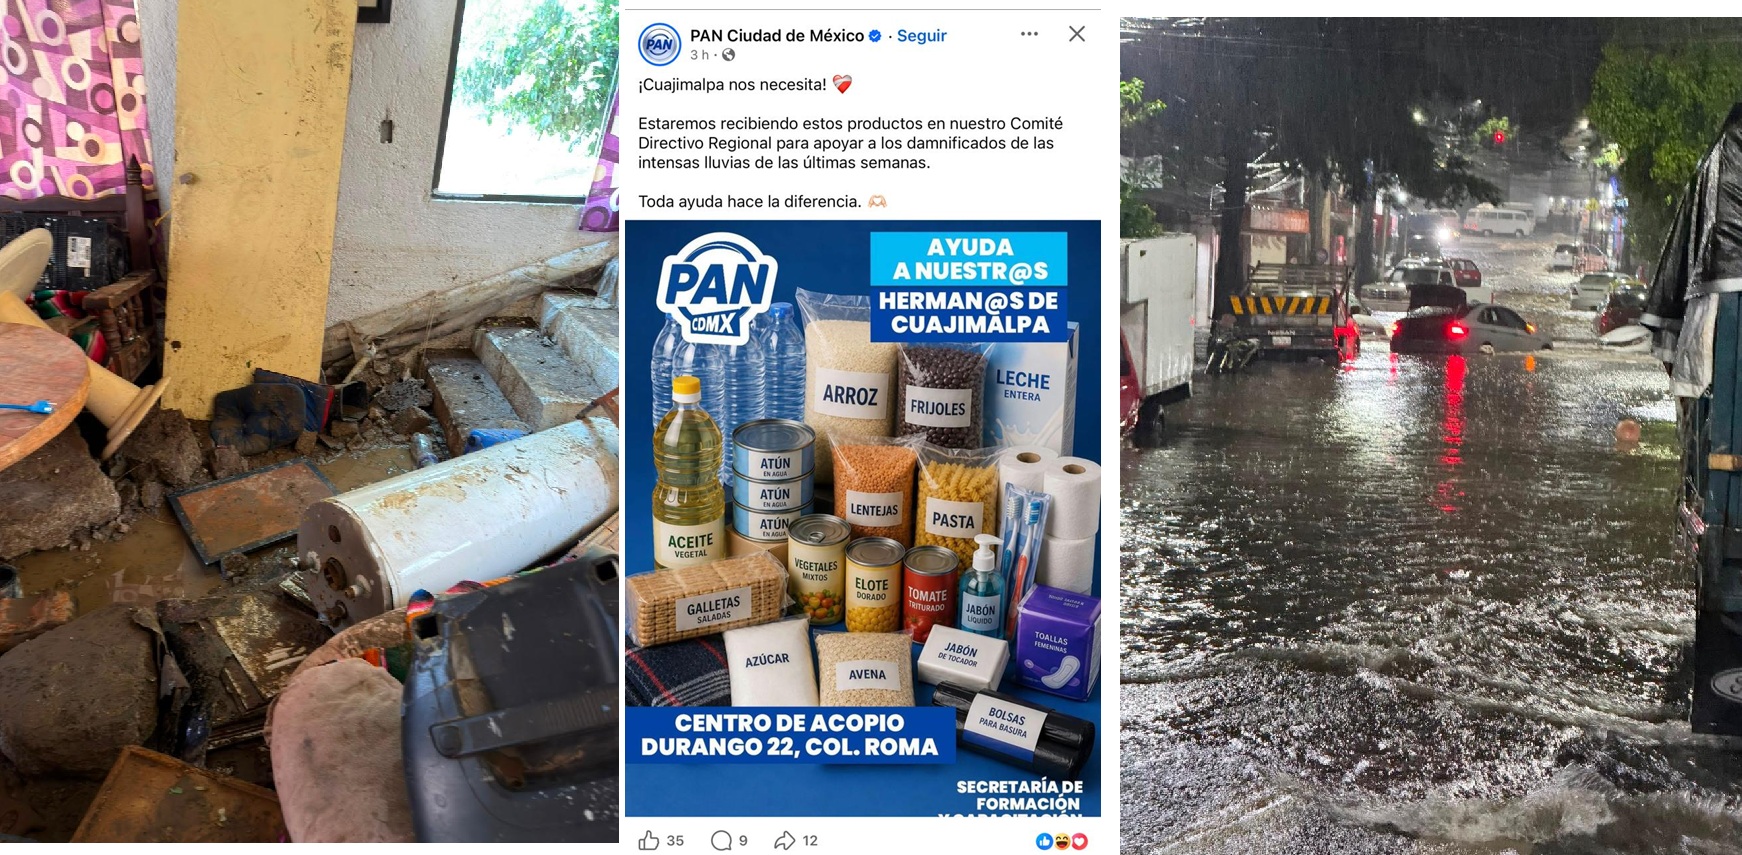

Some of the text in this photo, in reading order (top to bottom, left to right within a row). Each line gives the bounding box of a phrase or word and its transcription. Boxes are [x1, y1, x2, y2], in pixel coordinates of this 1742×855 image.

[646, 38, 673, 50] PAN
[691, 28, 947, 45] PAN Ciudad de México Seguir
[691, 49, 709, 60] 3 h
[639, 78, 826, 93] ¡Cuajimalpa nos necesita!
[639, 117, 1063, 132] Estaremos recibiendo estos productos en nuestro Comité
[639, 136, 1054, 152] Directivo Regional para apoyar a los damnificados de las
[639, 155, 930, 169] intensas lluvias de las últimas semanas.
[639, 195, 861, 210] Toda ayuda hace la diferencia.
[927, 238, 1014, 256] AYUDA
[893, 262, 1048, 285] A NUESTR@S
[665, 264, 769, 305] PAN
[879, 292, 1058, 315] HERMAN@S DE
[692, 312, 737, 333] CDMX
[891, 316, 1050, 333] CUAJIMALPA
[996, 369, 1050, 390] LECHE
[822, 384, 878, 406] ARROZ
[1004, 389, 1041, 402] ENTERA
[911, 399, 966, 416] FRIJOLES
[760, 457, 790, 469] ATÚN
[760, 487, 790, 500] ATÚN
[850, 503, 899, 516] LENTEJAS
[760, 517, 789, 530] ATÚN
[932, 512, 975, 529] PASTA
[668, 532, 714, 549] ACEITE
[674, 550, 708, 559] VEGETAL
[794, 557, 838, 572] VEGETALES
[802, 572, 828, 582] MIXTOS
[855, 577, 889, 592] ELOTE
[856, 591, 886, 601] DORADO
[908, 586, 947, 602] TOMATE
[687, 595, 741, 616] GALLETAS
[908, 601, 945, 612] TRITURADO
[966, 603, 995, 616] JABÓN
[697, 611, 731, 624] SALADAS
[1035, 631, 1068, 646] TOALLAS
[944, 642, 978, 658] JABÓN
[1034, 641, 1068, 654] FEMENINAS
[745, 653, 790, 668] AZÚCAR
[938, 652, 978, 668] DE TOCADOR
[849, 669, 886, 680] AVENA
[675, 714, 905, 732] CENTRO DE ACOPIO
[988, 707, 1026, 726] BOLSAS
[979, 717, 1027, 738] PARA BASURA
[641, 737, 939, 758] DURANGO 22, COL. ROMA
[957, 776, 1083, 793] SECRETARÍA DE
[977, 794, 1080, 810] FORMACIÓN
[667, 834, 684, 846] 35
[739, 834, 748, 846] 9
[803, 834, 818, 846] 12
